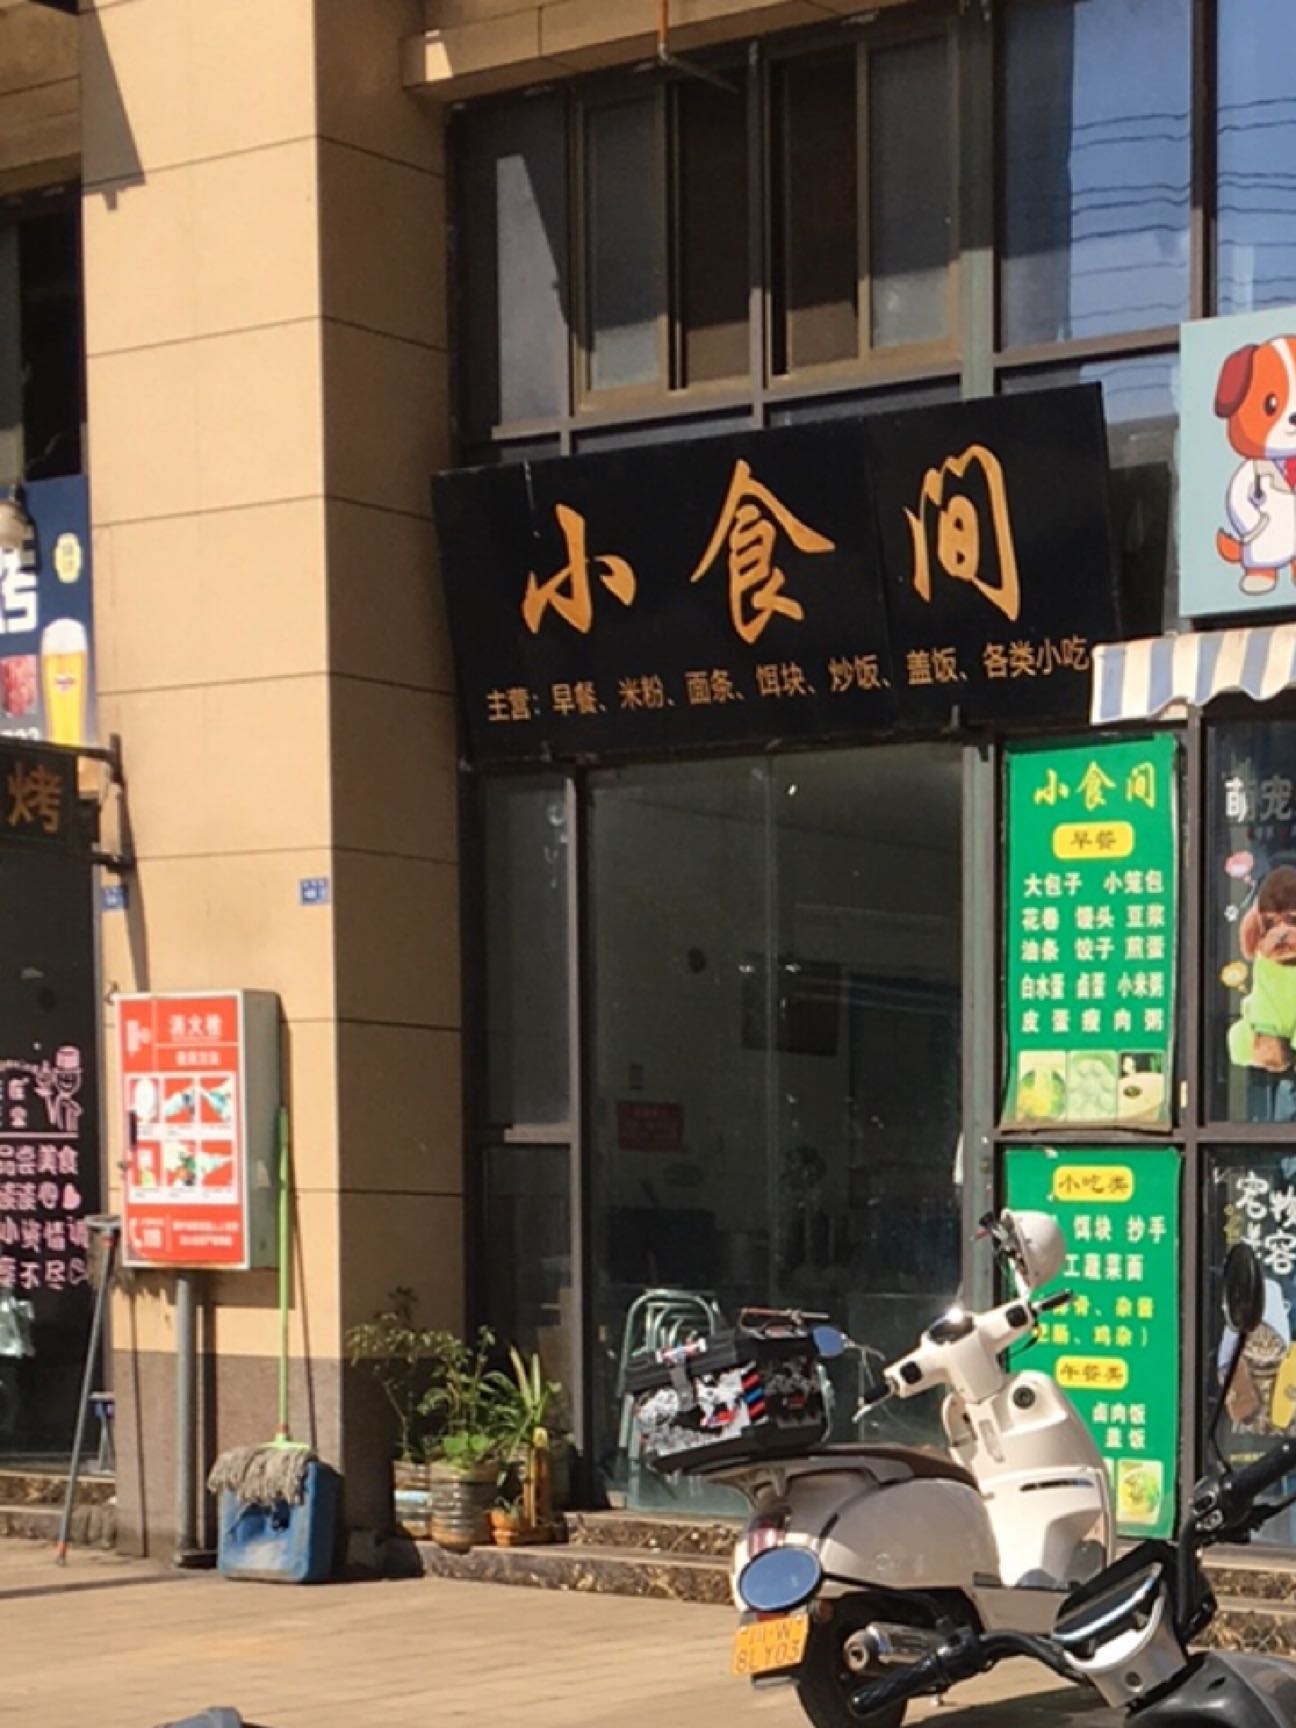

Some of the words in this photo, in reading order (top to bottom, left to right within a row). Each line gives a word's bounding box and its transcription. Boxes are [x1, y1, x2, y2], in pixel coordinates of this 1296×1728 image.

[520, 442, 1021, 645] 小食间
[7, 762, 62, 836] 烤
[1033, 761, 1156, 811] 小食间
[1070, 829, 1117, 851] 早餐
[1024, 872, 1082, 898] 大包子
[1103, 869, 1163, 895] 小笼包
[1022, 906, 1060, 931] 花卷
[1075, 905, 1114, 930] 馒头
[1126, 903, 1165, 929] 豆浆
